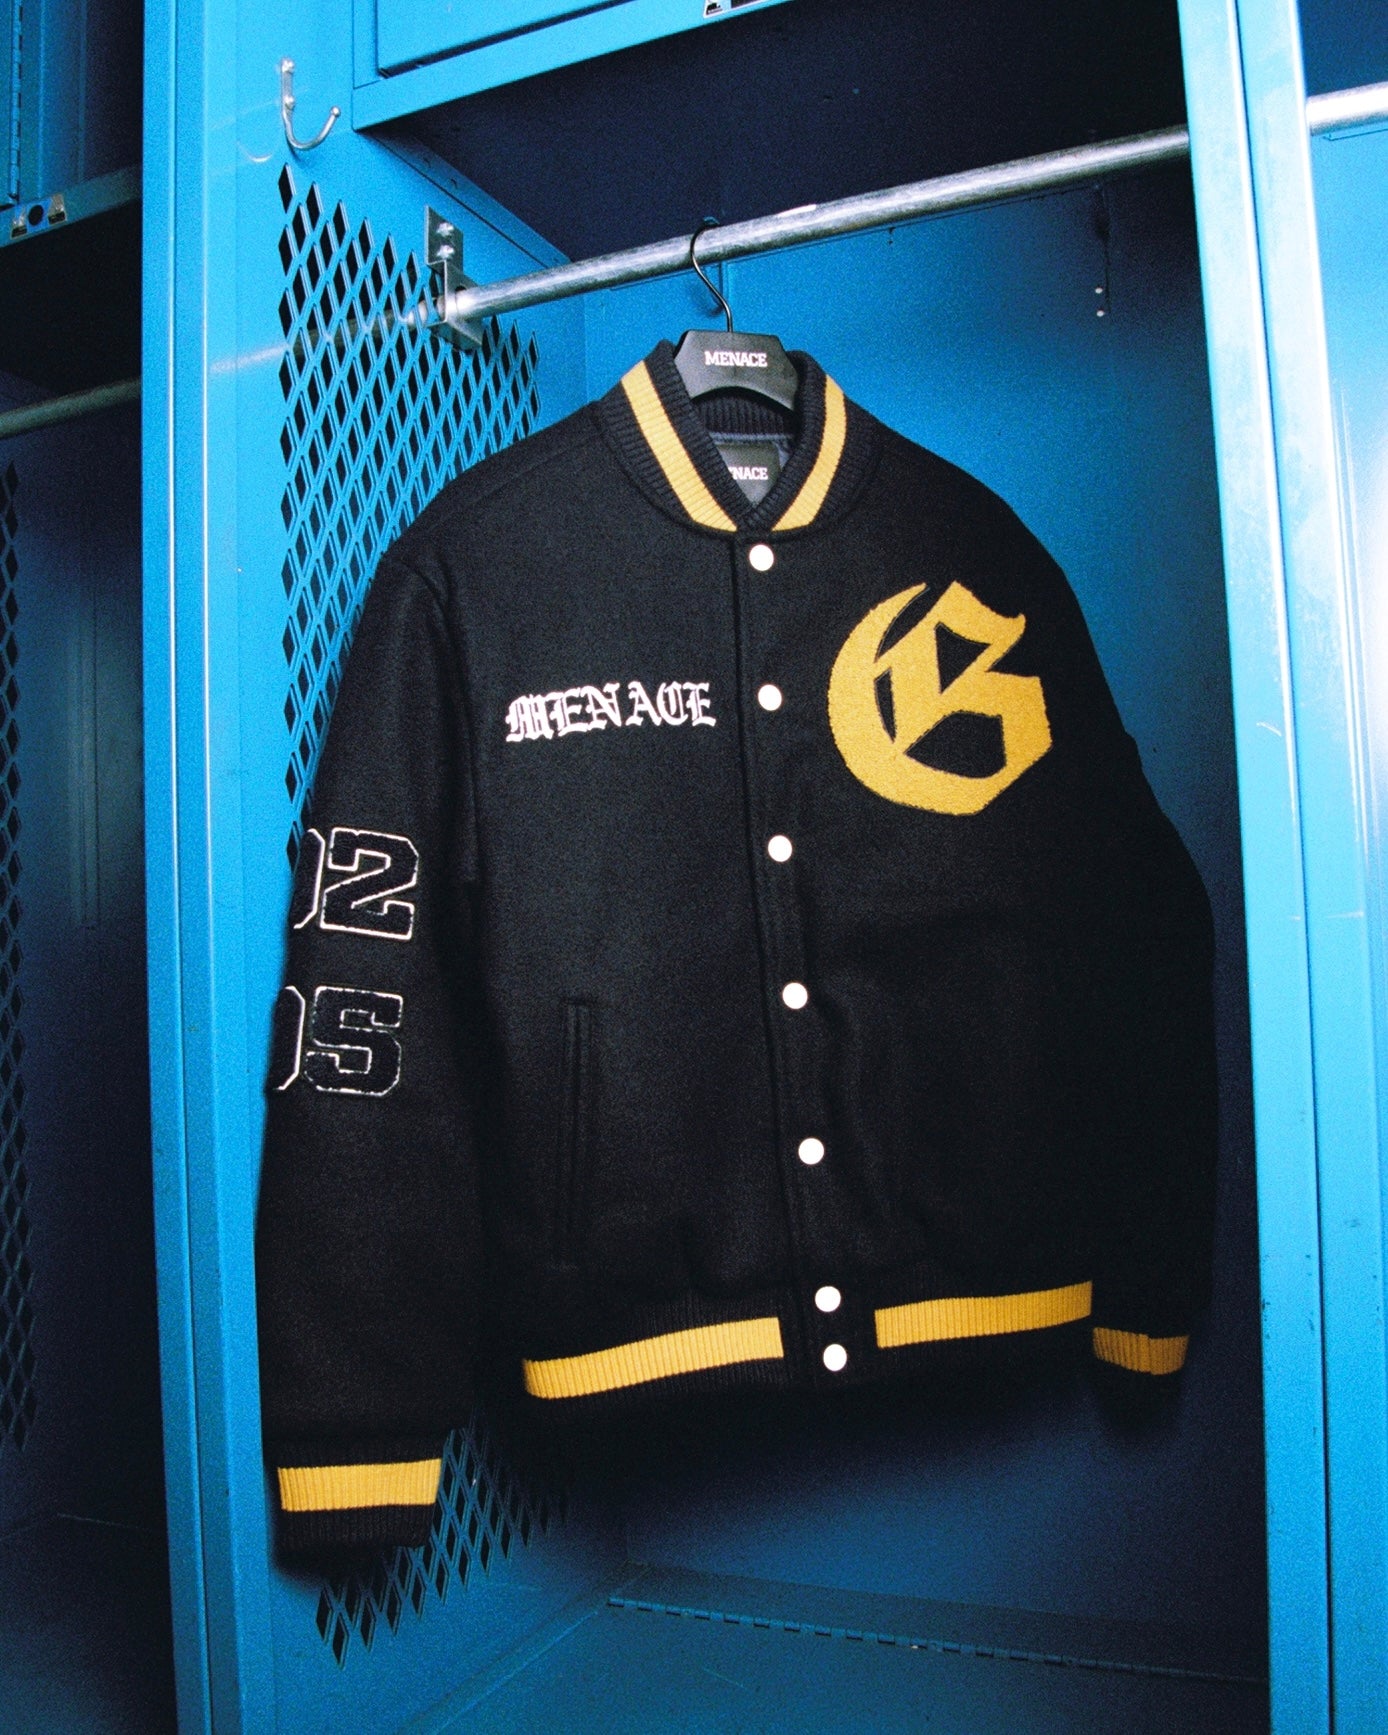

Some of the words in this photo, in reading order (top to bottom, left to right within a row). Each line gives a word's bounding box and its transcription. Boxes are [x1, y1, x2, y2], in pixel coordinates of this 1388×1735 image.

[704, 351, 768, 367] MENACE
[728, 466, 769, 480] NACE
[505, 680, 717, 742] MENACE
